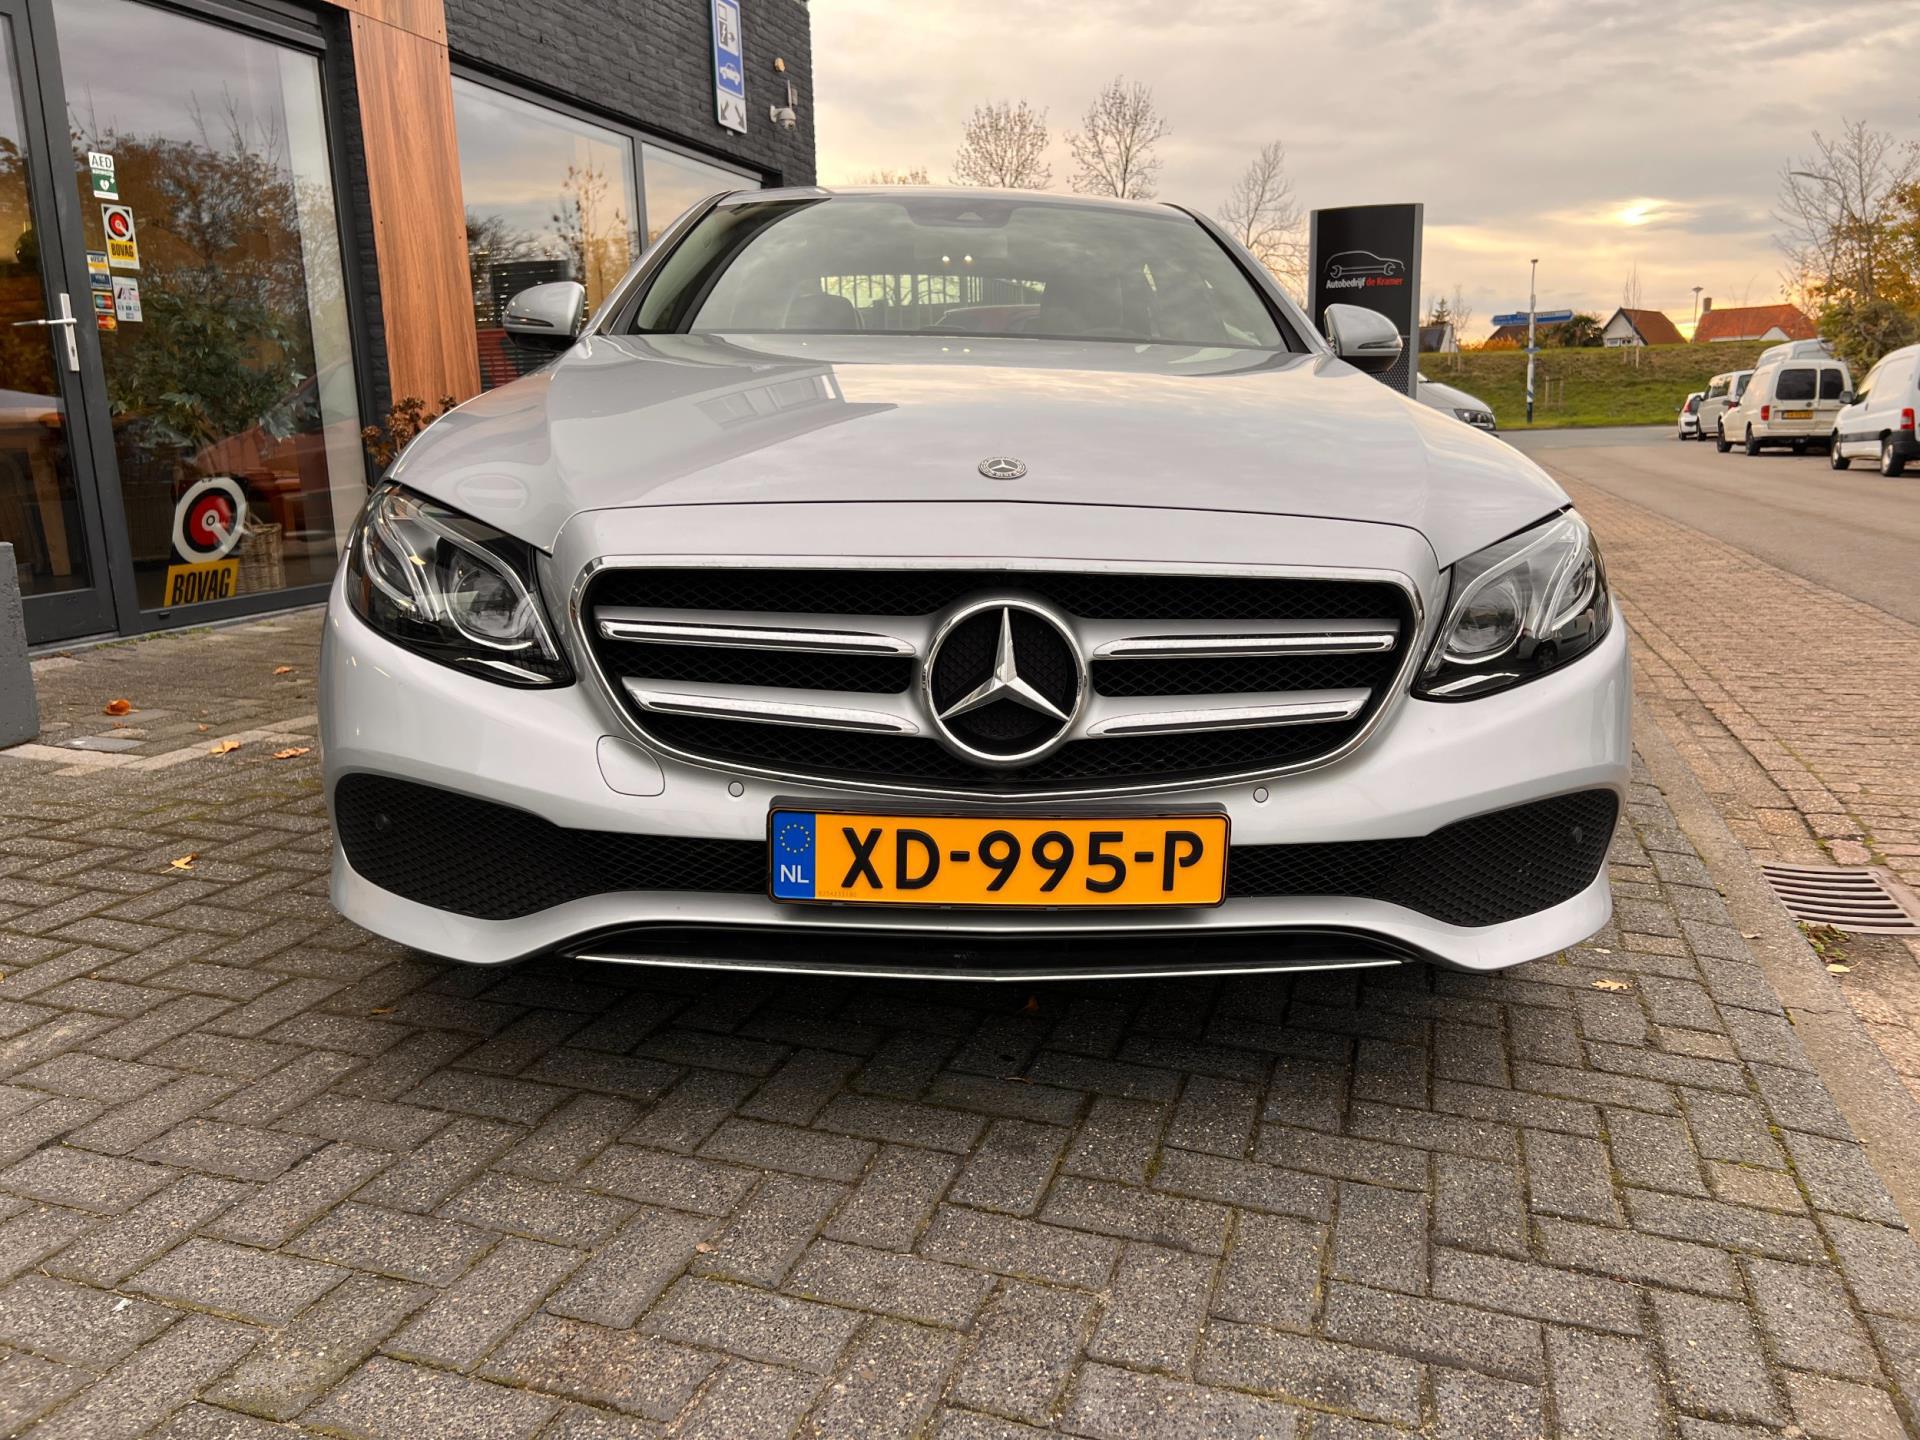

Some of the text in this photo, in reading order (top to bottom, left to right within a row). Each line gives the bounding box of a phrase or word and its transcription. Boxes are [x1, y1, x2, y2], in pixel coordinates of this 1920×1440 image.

[91, 154, 112, 169] AED
[111, 241, 134, 258] BOVAG
[1326, 277, 1403, 289] Autobedrijf de Kramer
[171, 567, 231, 605] BOVAG
[841, 827, 1204, 893] XD-995-P
[779, 864, 809, 884] NL
